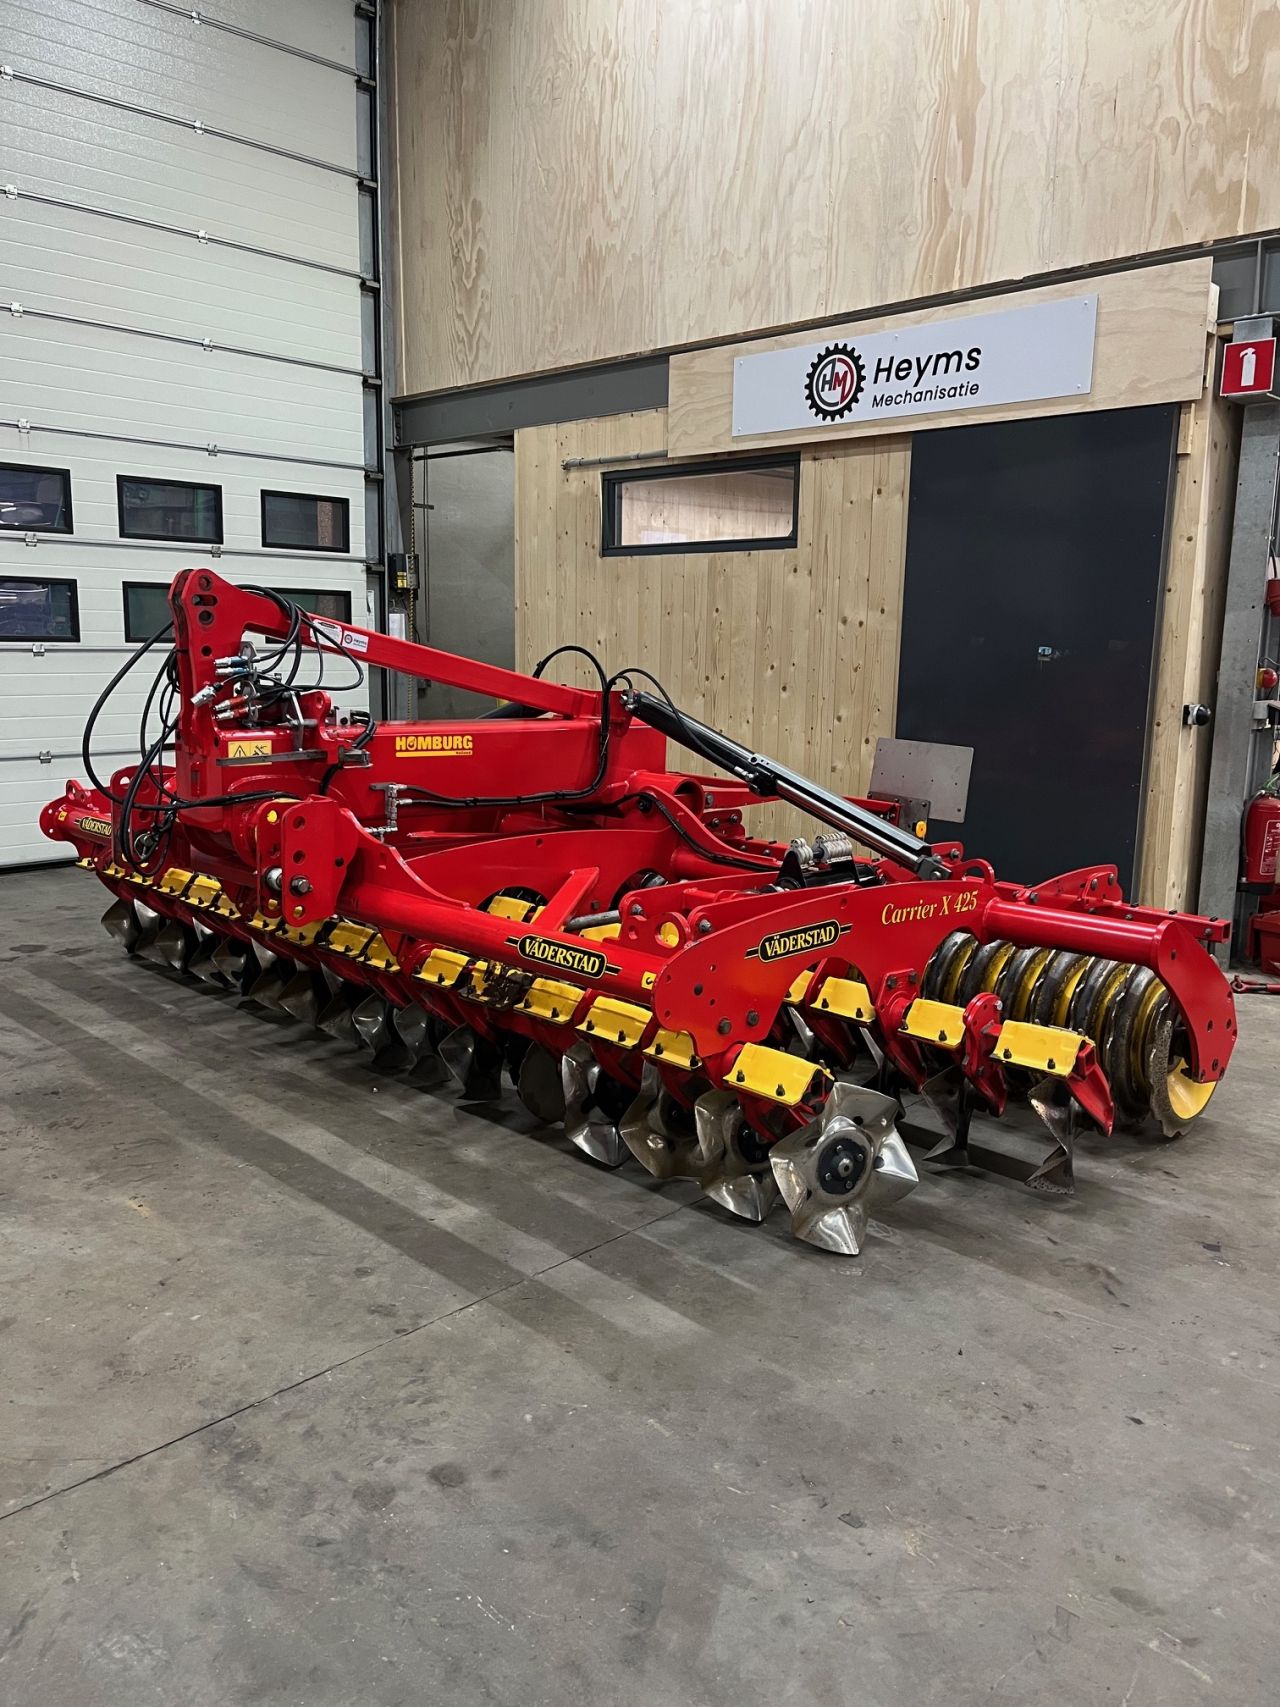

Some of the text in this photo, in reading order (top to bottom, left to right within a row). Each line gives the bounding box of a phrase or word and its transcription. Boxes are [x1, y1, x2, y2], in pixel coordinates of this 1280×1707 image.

[873, 347, 982, 388] Heyms
[871, 380, 980, 409] Mechanisatie
[395, 735, 473, 751] HOMBURG
[881, 890, 979, 925] Carrier X 425
[525, 937, 600, 974] VÄDERSTAD
[764, 926, 836, 957] VÄDERSTAD
